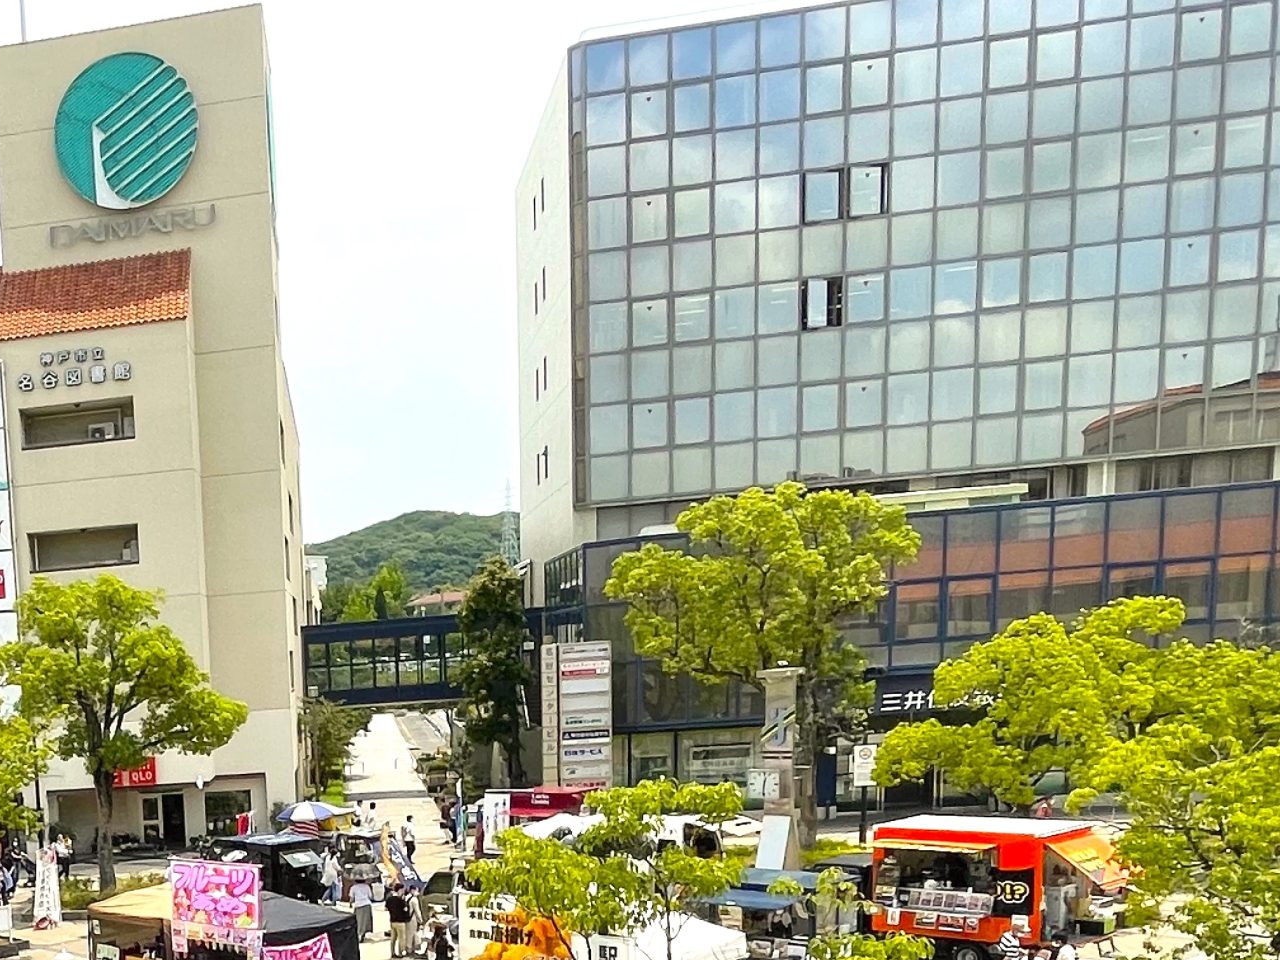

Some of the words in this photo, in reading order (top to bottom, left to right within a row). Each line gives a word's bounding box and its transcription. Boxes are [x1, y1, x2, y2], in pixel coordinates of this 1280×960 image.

[49, 203, 216, 249] DAIMARU
[18, 361, 132, 392] 名谷図書館
[173, 864, 255, 896] フルーツ
